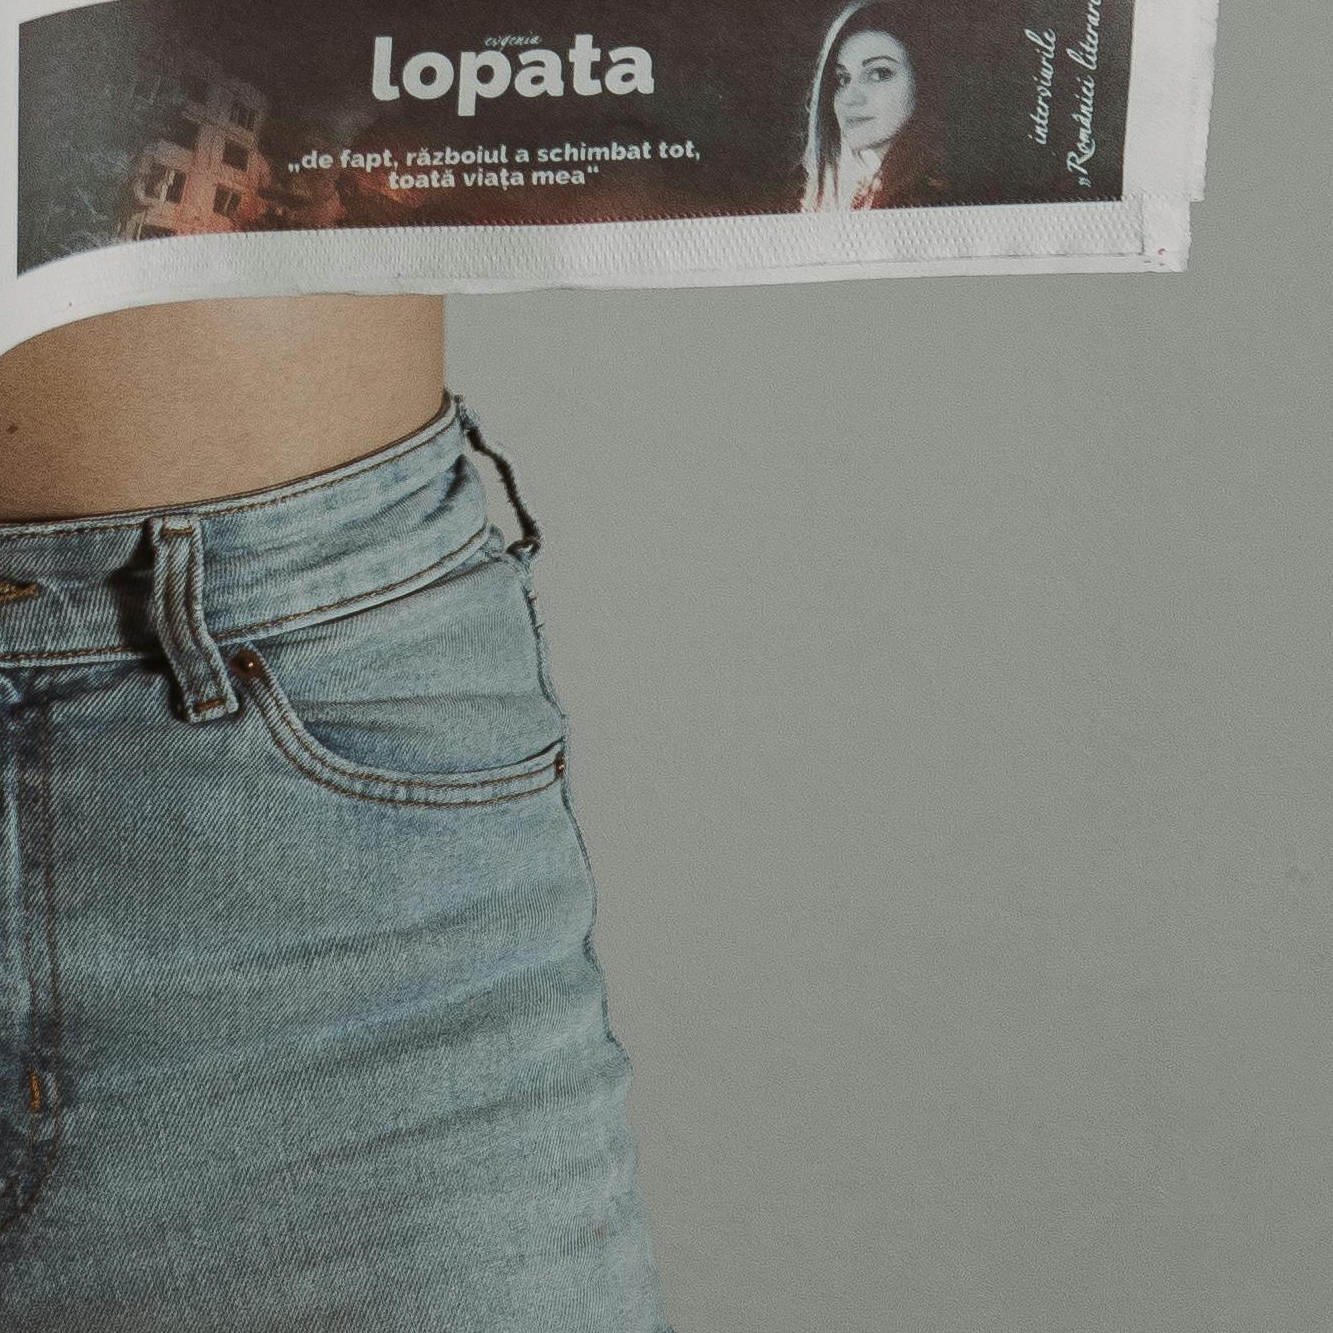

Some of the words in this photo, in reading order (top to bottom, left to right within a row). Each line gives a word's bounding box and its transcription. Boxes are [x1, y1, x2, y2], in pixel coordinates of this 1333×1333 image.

[371, 33, 656, 117] lopata
[1023, 27, 1059, 146] interviurile
[287, 148, 334, 174] „de
[340, 146, 399, 173] fapt,
[406, 143, 508, 167] războiul
[515, 148, 530, 164] a
[537, 141, 652, 164] schimbat
[658, 138, 702, 163] tot,
[388, 169, 456, 190] toată
[463, 166, 526, 194] viața
